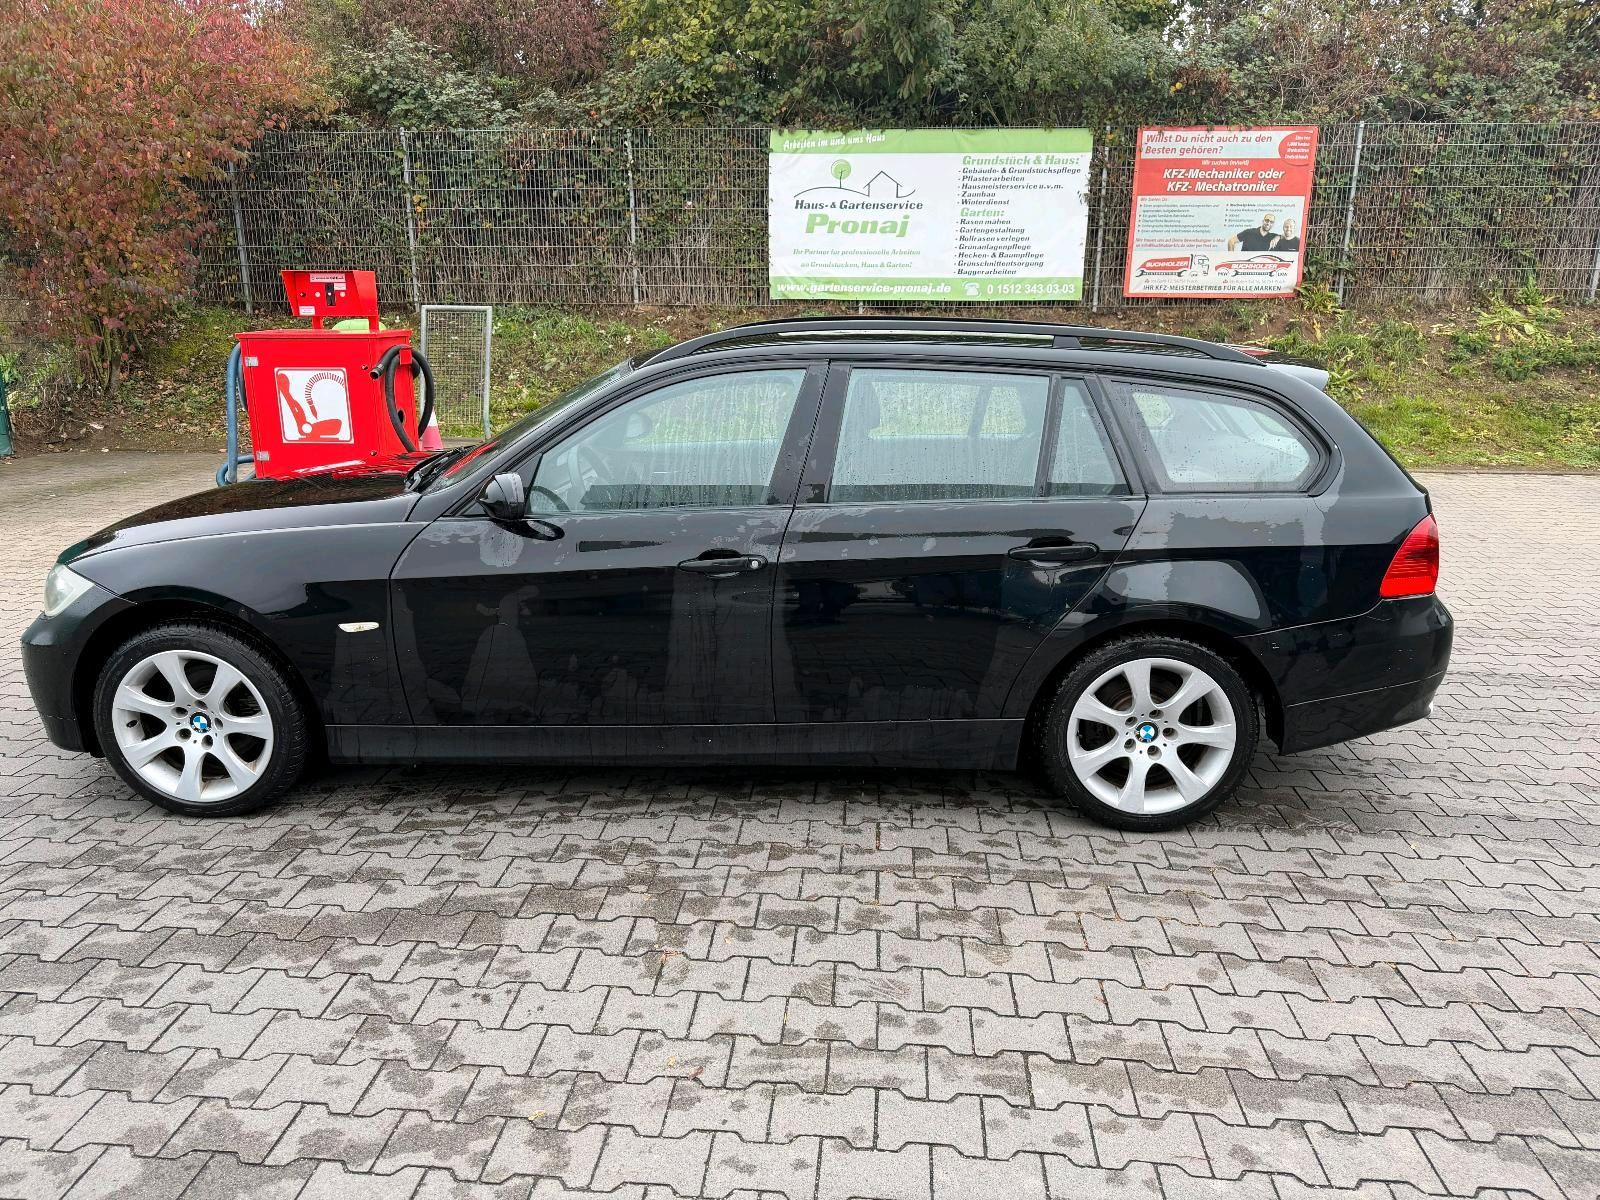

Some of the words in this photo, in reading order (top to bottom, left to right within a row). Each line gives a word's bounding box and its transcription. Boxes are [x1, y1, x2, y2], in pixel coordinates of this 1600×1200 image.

[784, 139, 816, 151] Arbeiten
[818, 138, 828, 147] im
[830, 136, 846, 146] und
[848, 136, 864, 144] ums
[866, 133, 886, 144] Haus
[1146, 134, 1173, 143] Willst
[1174, 134, 1188, 143] Du
[1190, 134, 1212, 143] nicht
[1216, 134, 1238, 143] auch
[1254, 134, 1272, 143] den
[1145, 146, 1177, 154] Besten
[1179, 146, 1224, 156] gehören?
[962, 156, 1030, 165] Grundstück
[1033, 156, 1042, 164] &
[1045, 155, 1080, 164] Haus:
[1163, 168, 1256, 179] KFZ-Mechaniker
[1258, 169, 1284, 179] oder
[1167, 182, 1192, 192] KFZ-
[1194, 181, 1279, 192] Mechatroniker
[839, 200, 924, 210] Gartenservice
[960, 208, 1004, 217] Garten:
[805, 213, 910, 238] Pronaj
[777, 282, 951, 294] www.gartenservice-pronaj.de
[987, 284, 994, 294] 0
[998, 284, 1022, 294] 1512
[1024, 284, 1042, 294] 343
